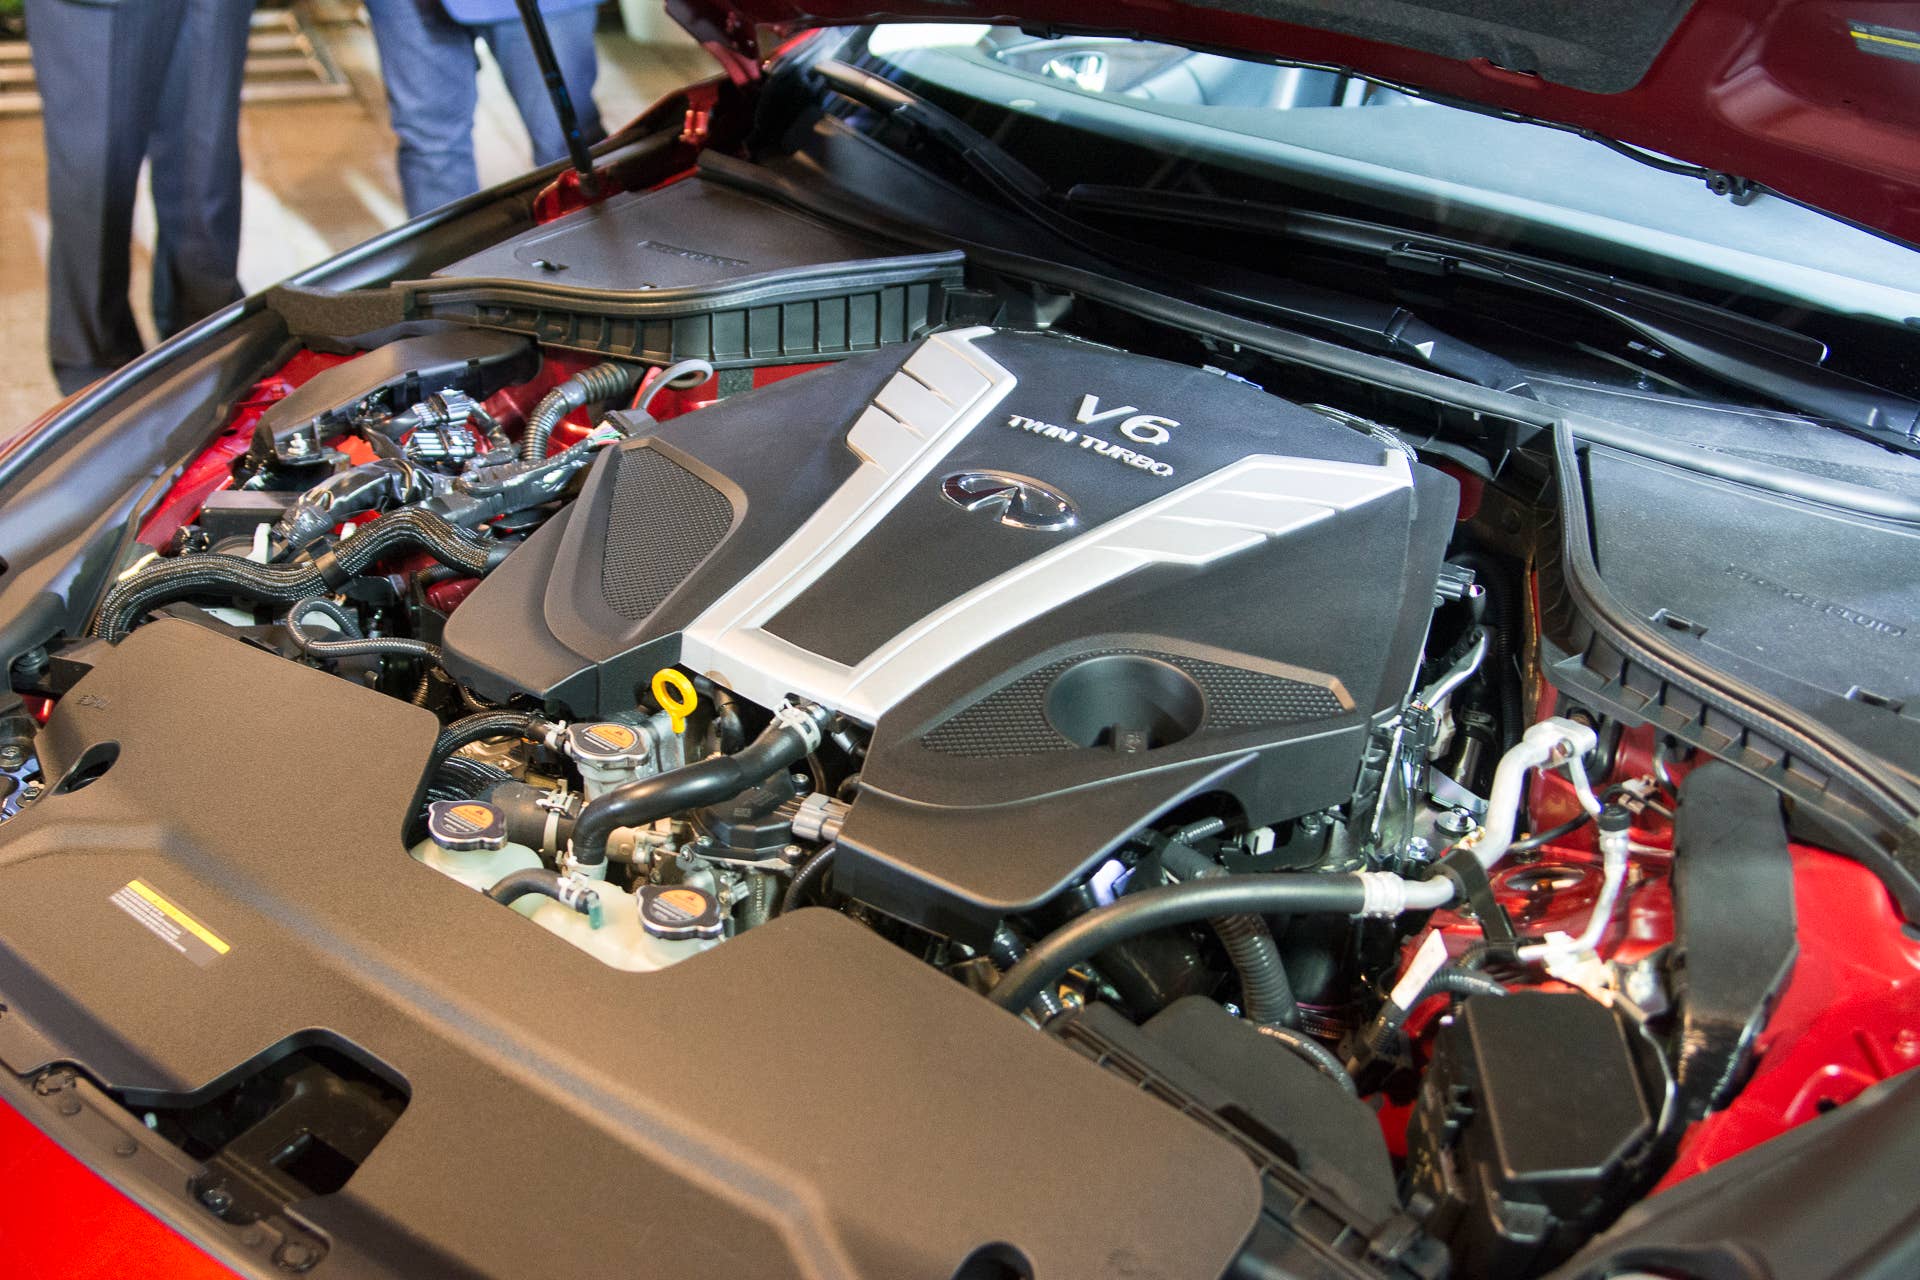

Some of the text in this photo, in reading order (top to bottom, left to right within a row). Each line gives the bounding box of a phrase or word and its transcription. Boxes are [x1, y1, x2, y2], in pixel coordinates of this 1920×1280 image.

[1007, 414, 1174, 477] TWIN TURBO
[1076, 393, 1181, 445] V6
